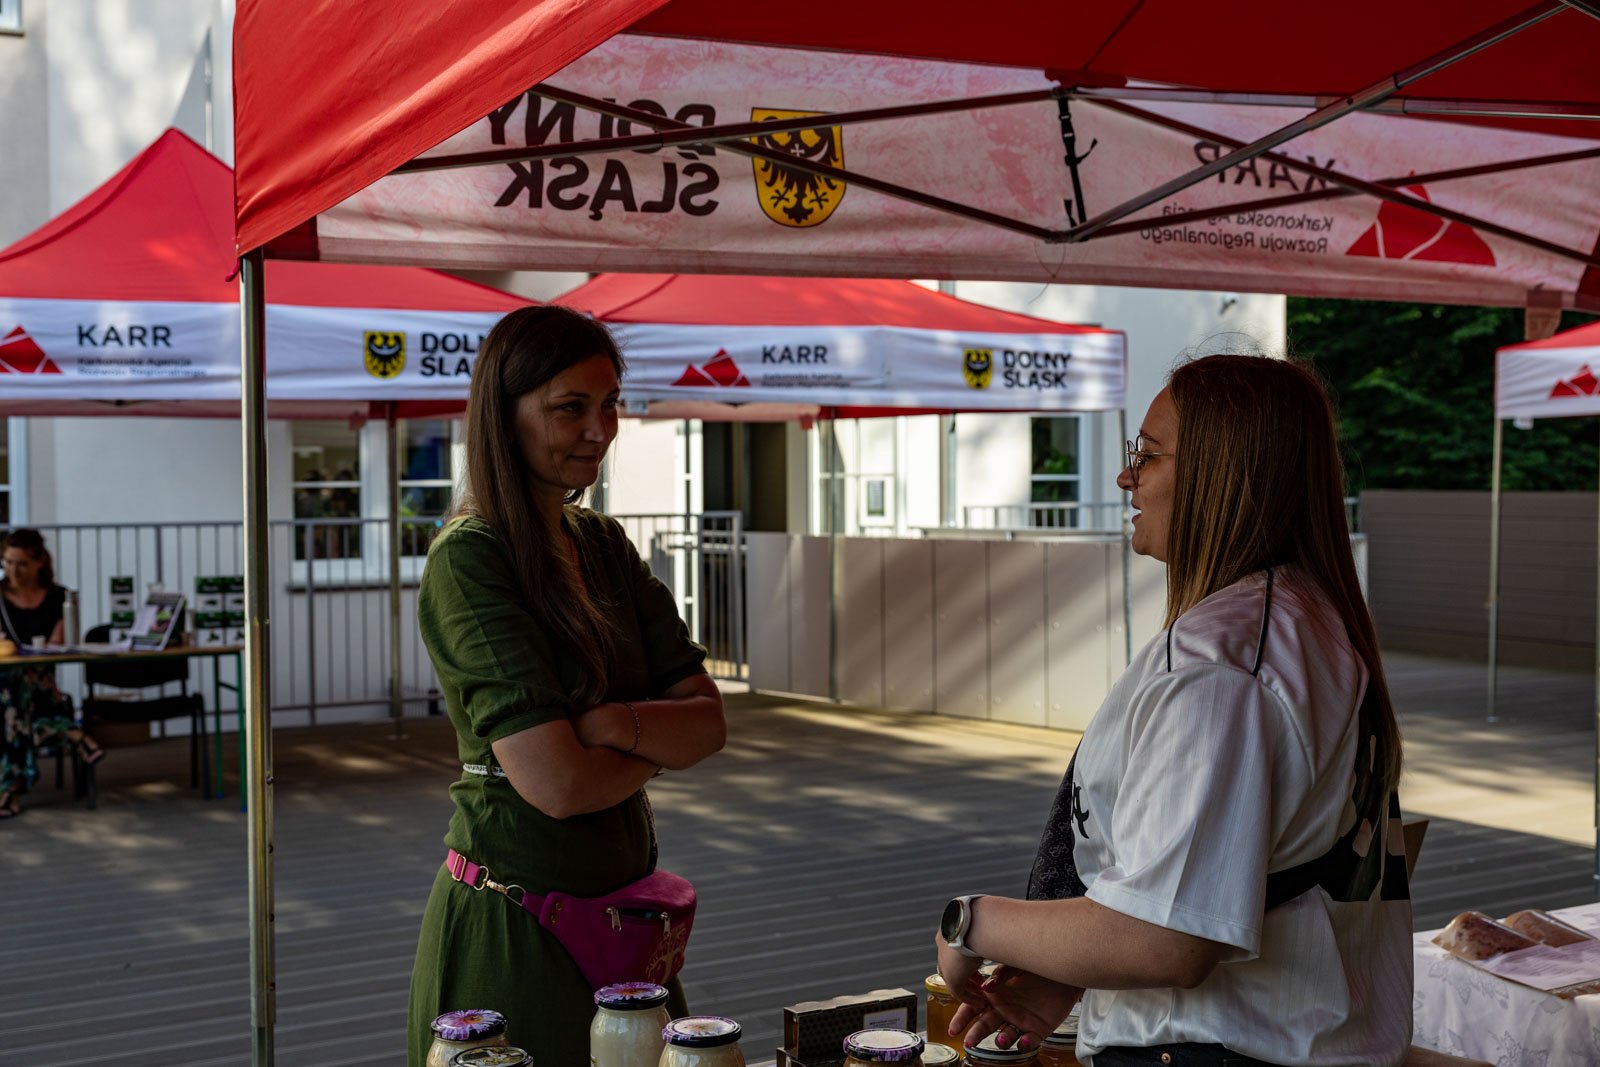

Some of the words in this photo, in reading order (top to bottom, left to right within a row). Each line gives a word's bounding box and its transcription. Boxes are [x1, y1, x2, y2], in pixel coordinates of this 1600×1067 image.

[77, 324, 172, 348] KARR
[421, 333, 486, 353] DOL
[761, 345, 829, 364] KARR
[1003, 350, 1073, 369] DOLNY
